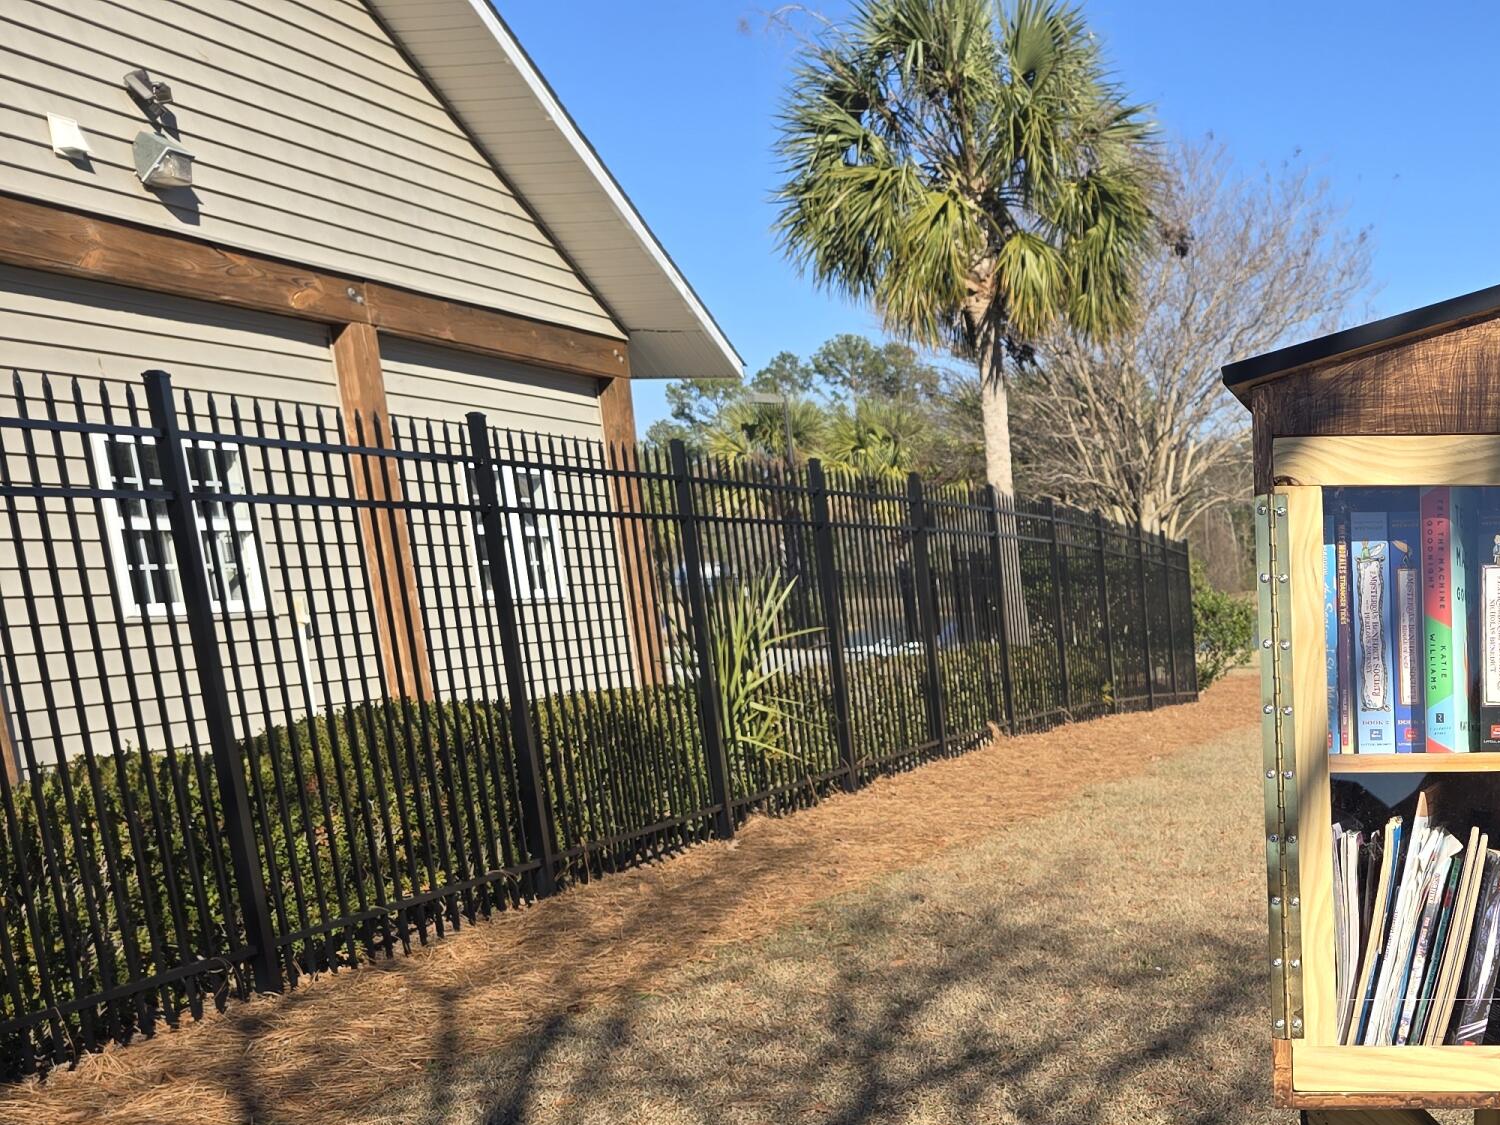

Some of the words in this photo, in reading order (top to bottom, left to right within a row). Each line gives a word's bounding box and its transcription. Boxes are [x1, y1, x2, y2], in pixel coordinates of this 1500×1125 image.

[1436, 498, 1444, 526] TELL
[1338, 544, 1347, 574] MORALES
[1426, 520, 1435, 590] GOODNIGHT
[1339, 575, 1347, 607] STRANGER
[1370, 575, 1379, 619] MYSTERIOUS
[1438, 558, 1446, 610] MACHINE
[1372, 621, 1380, 661] BENEDICT
[1429, 633, 1437, 690] WILLIAMS
[1440, 645, 1448, 679] KATIE
[1371, 664, 1380, 697] SOCIETY
